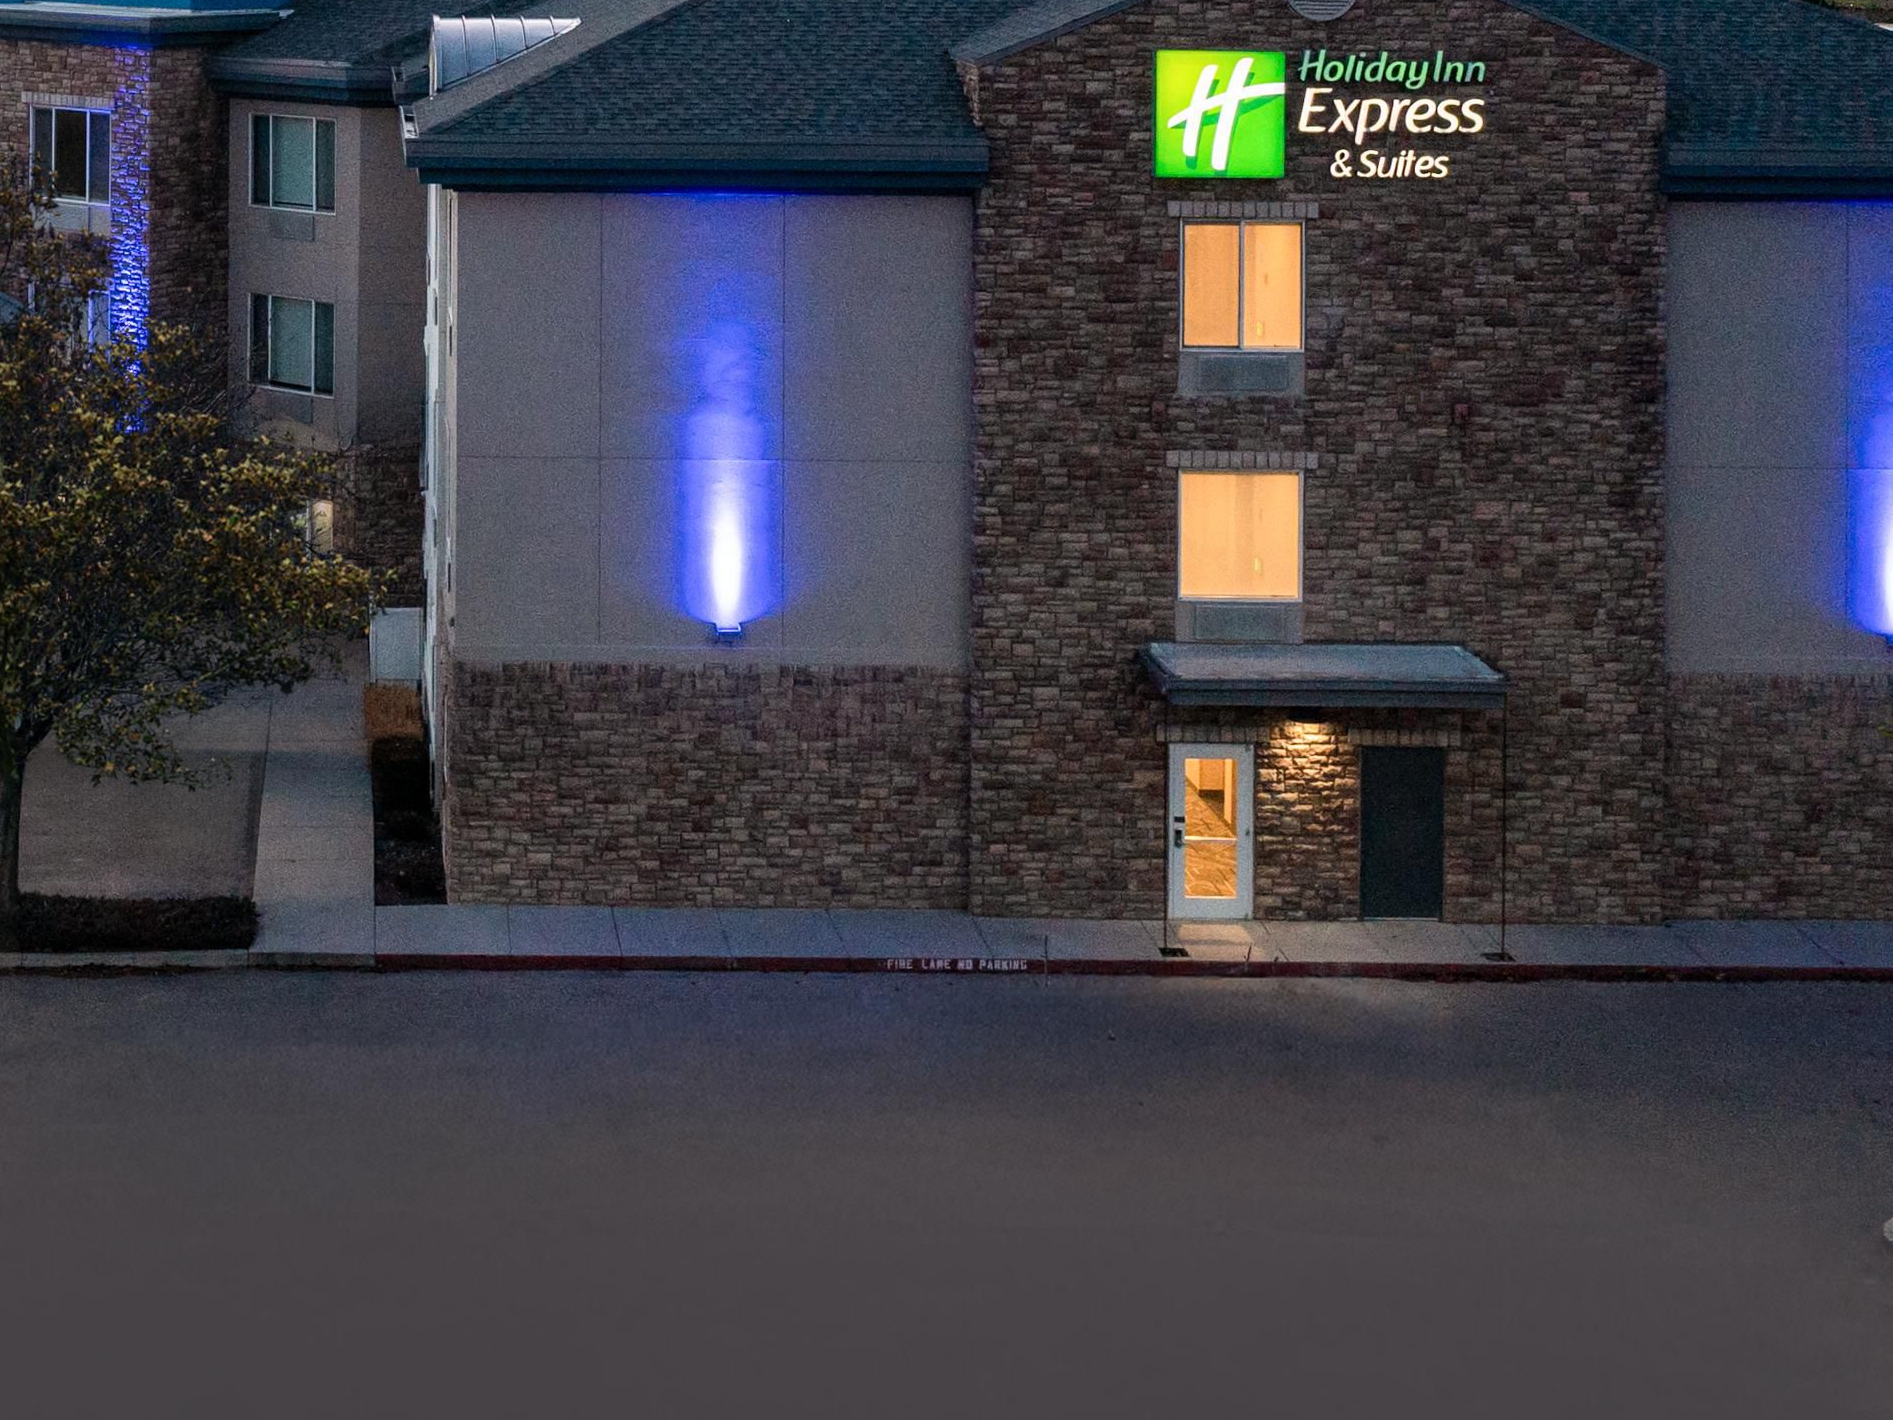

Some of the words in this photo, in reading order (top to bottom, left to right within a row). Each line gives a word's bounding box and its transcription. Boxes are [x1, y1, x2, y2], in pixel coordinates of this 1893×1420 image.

[1298, 49, 1429, 90] Holiday
[1433, 50, 1486, 82] Inn
[1298, 87, 1485, 145] Express
[1330, 149, 1352, 178] &
[1356, 149, 1449, 178] Suites
[887, 959, 913, 970] FIRE
[921, 959, 951, 970] LANE
[957, 959, 973, 970] NO
[979, 959, 1027, 970] PARKING
